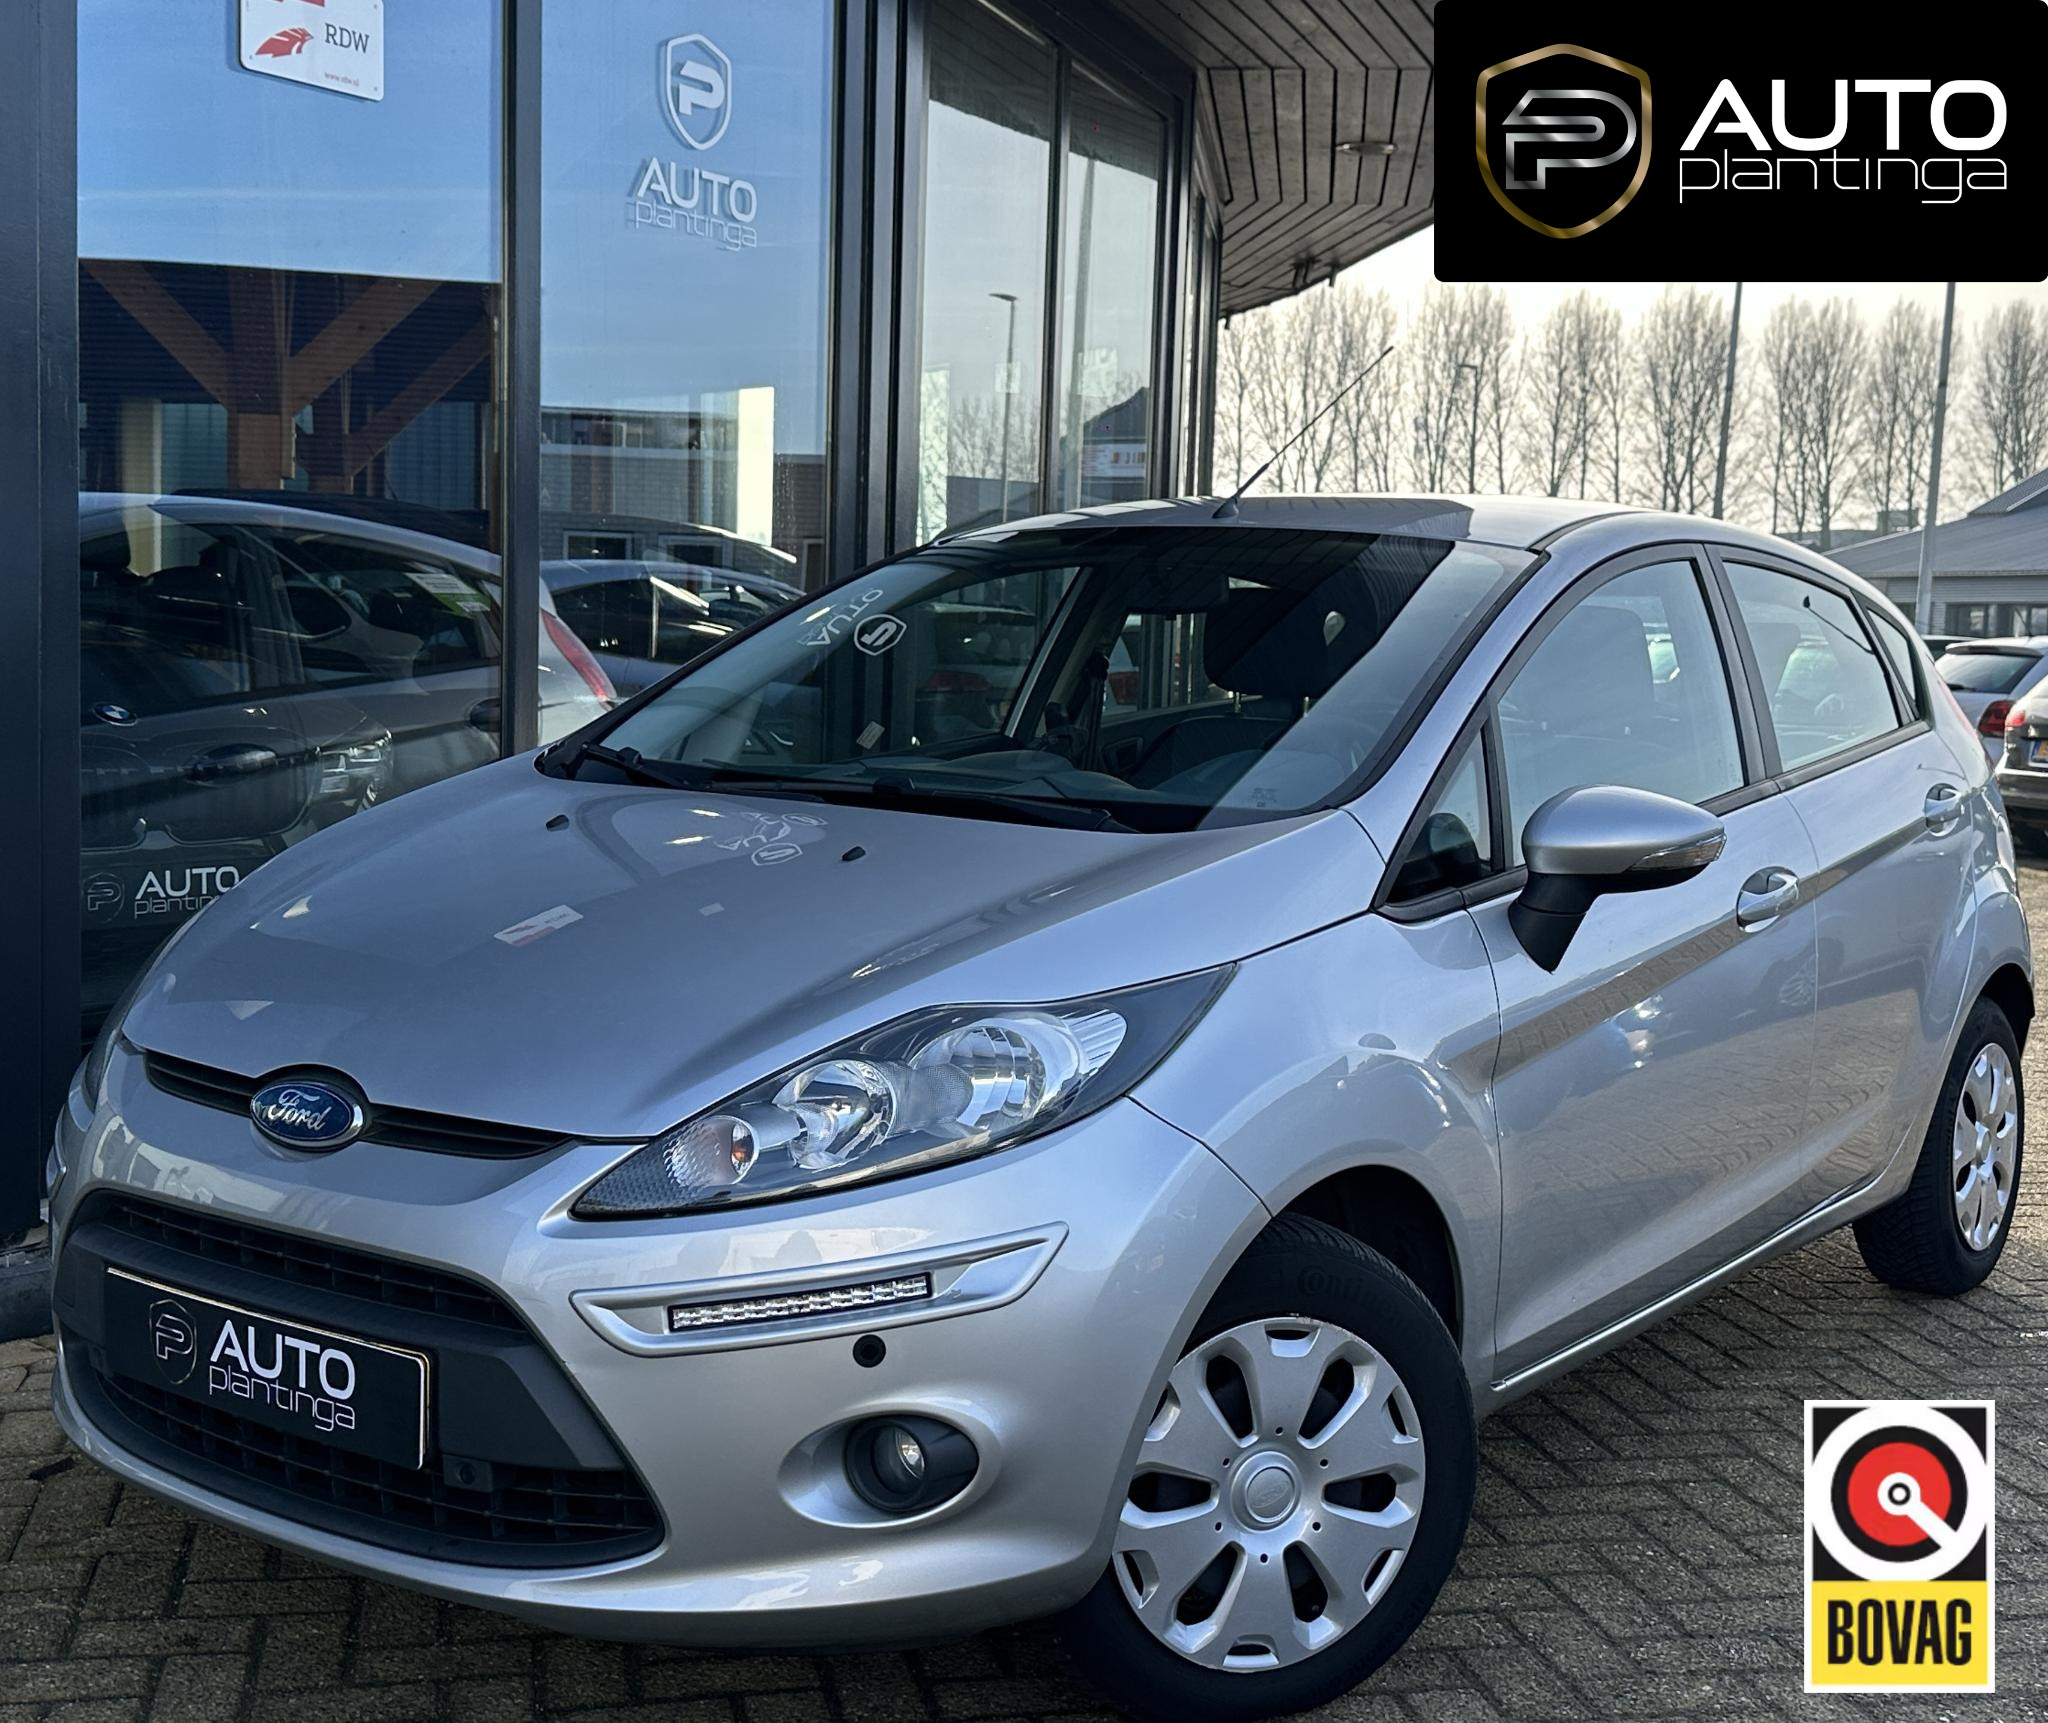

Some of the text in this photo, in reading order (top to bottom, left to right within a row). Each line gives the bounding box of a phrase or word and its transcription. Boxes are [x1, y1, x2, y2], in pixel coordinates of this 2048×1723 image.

[324, 22, 370, 54] RDW
[637, 156, 757, 223] AUTO
[635, 199, 757, 252] plantinga
[135, 865, 240, 900] AUTO
[134, 894, 221, 920] plantin
[268, 1088, 332, 1132] Ford
[209, 1319, 356, 1400] AUTO
[209, 1364, 356, 1432] plantinga
